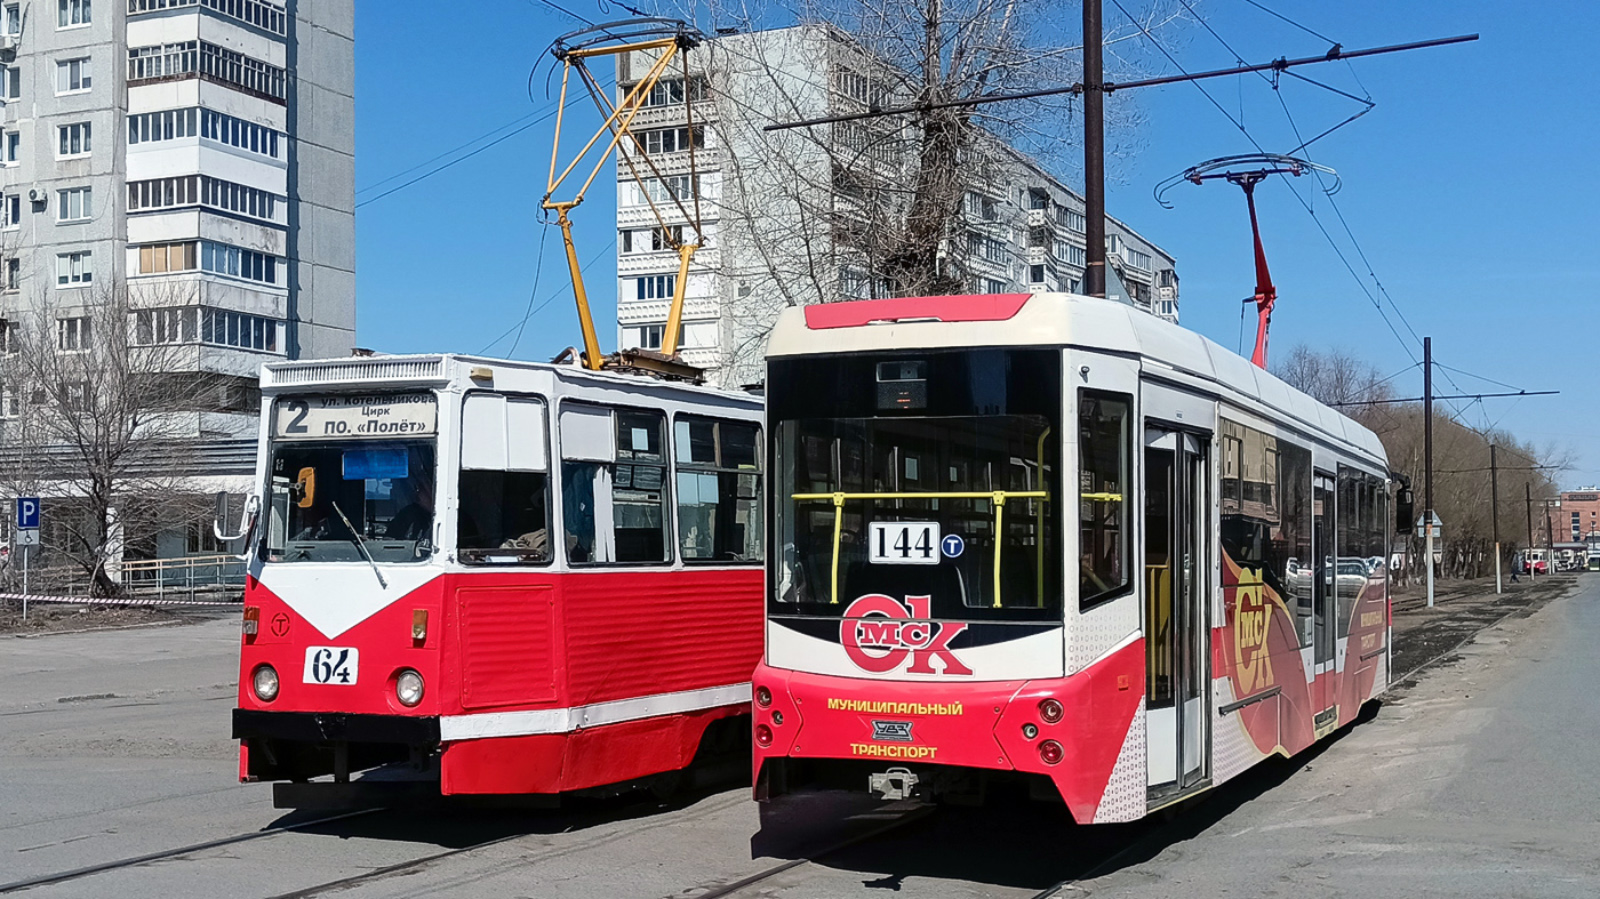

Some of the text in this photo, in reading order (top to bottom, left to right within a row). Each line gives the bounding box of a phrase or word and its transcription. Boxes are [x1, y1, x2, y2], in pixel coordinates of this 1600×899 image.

[321, 397, 339, 408] ул.
[285, 400, 310, 434] 2
[361, 407, 390, 418] Цирк
[357, 418, 426, 433] «Полёт»
[875, 527, 933, 558] 144
[312, 648, 350, 683] 64
[827, 698, 963, 716] МУНИЦИПАЛЬНЫЙ
[849, 743, 938, 759] ТРАНСПОРТ
